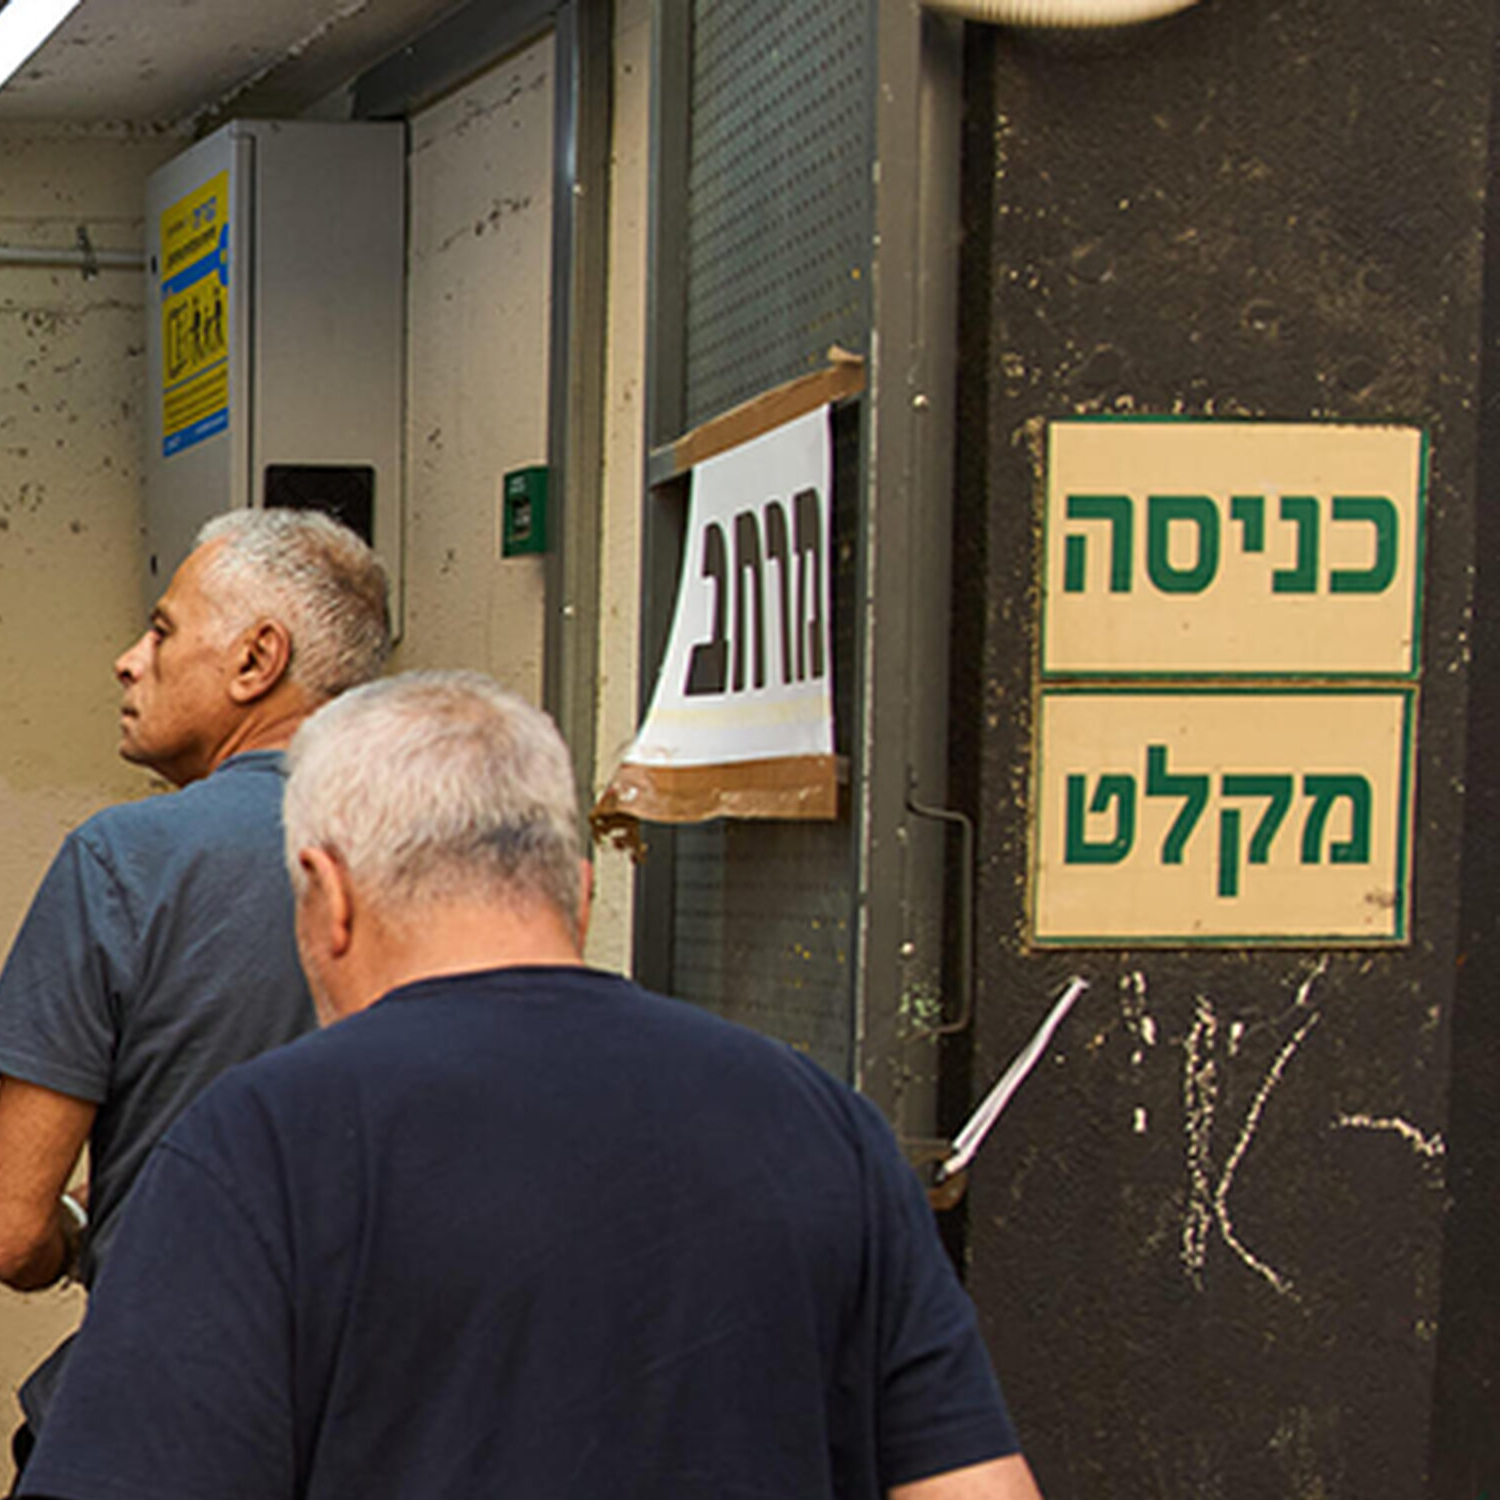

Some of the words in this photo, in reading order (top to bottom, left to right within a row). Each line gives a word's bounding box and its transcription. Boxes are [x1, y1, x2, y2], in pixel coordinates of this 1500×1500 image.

[684, 487, 824, 696] מרחב
[1065, 496, 1397, 594] כניסה
[1064, 745, 1372, 897] מקלט
